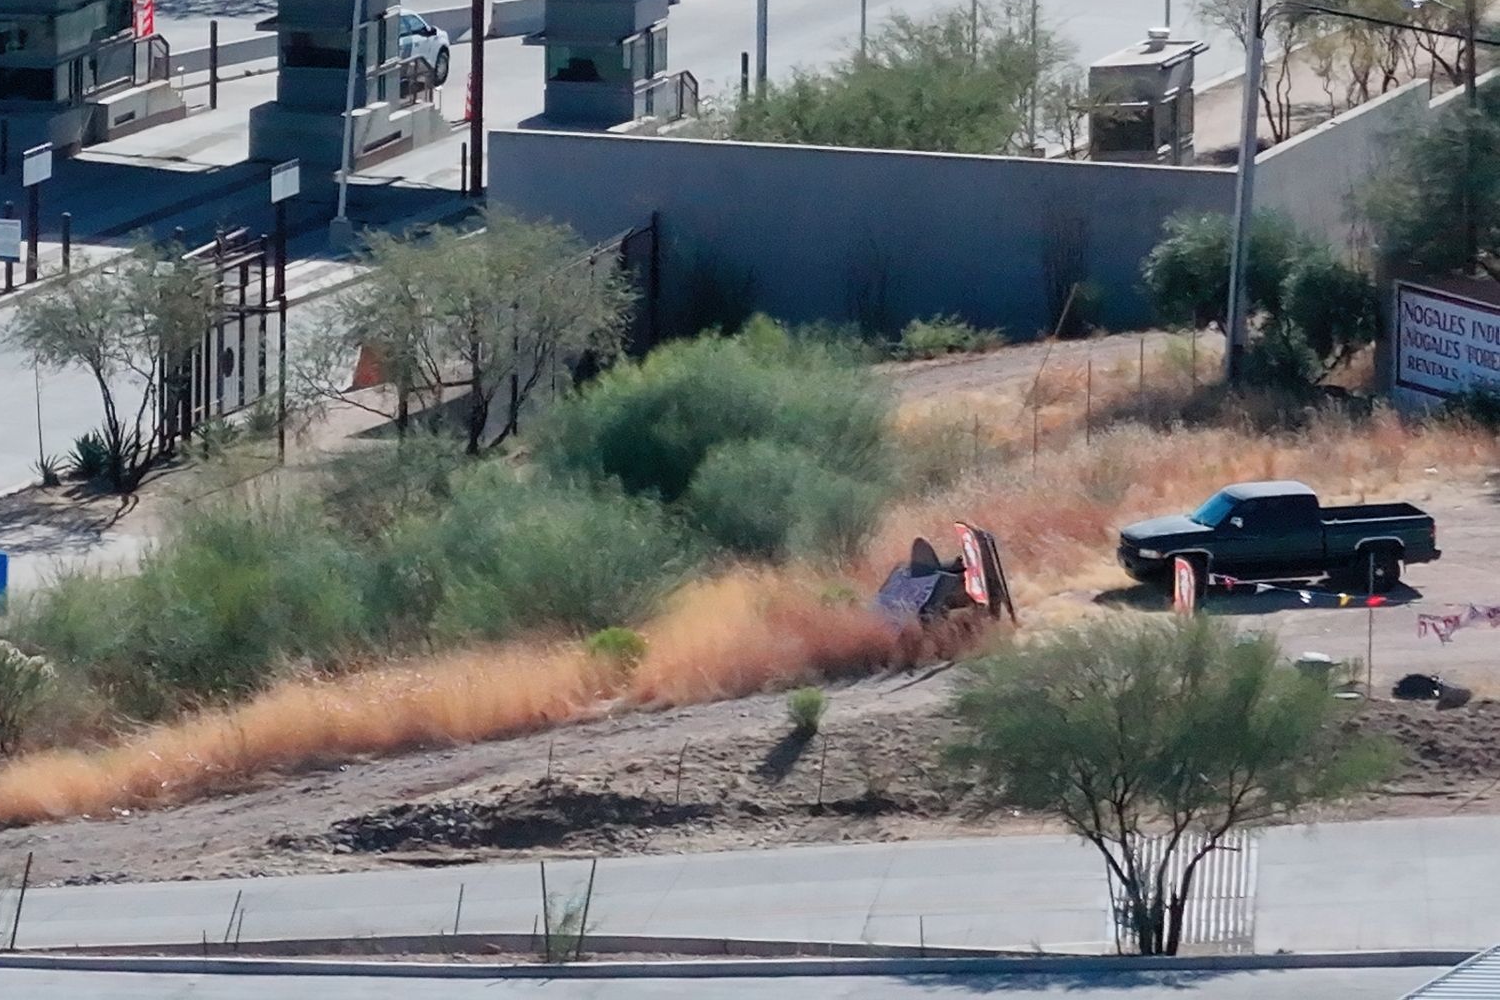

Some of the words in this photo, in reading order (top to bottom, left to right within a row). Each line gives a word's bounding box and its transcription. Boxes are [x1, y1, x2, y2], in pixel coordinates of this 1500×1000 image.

[1403, 300, 1466, 337] NOGALES
[1403, 327, 1461, 360] NOGALES
[1407, 354, 1459, 382] RENTALS
